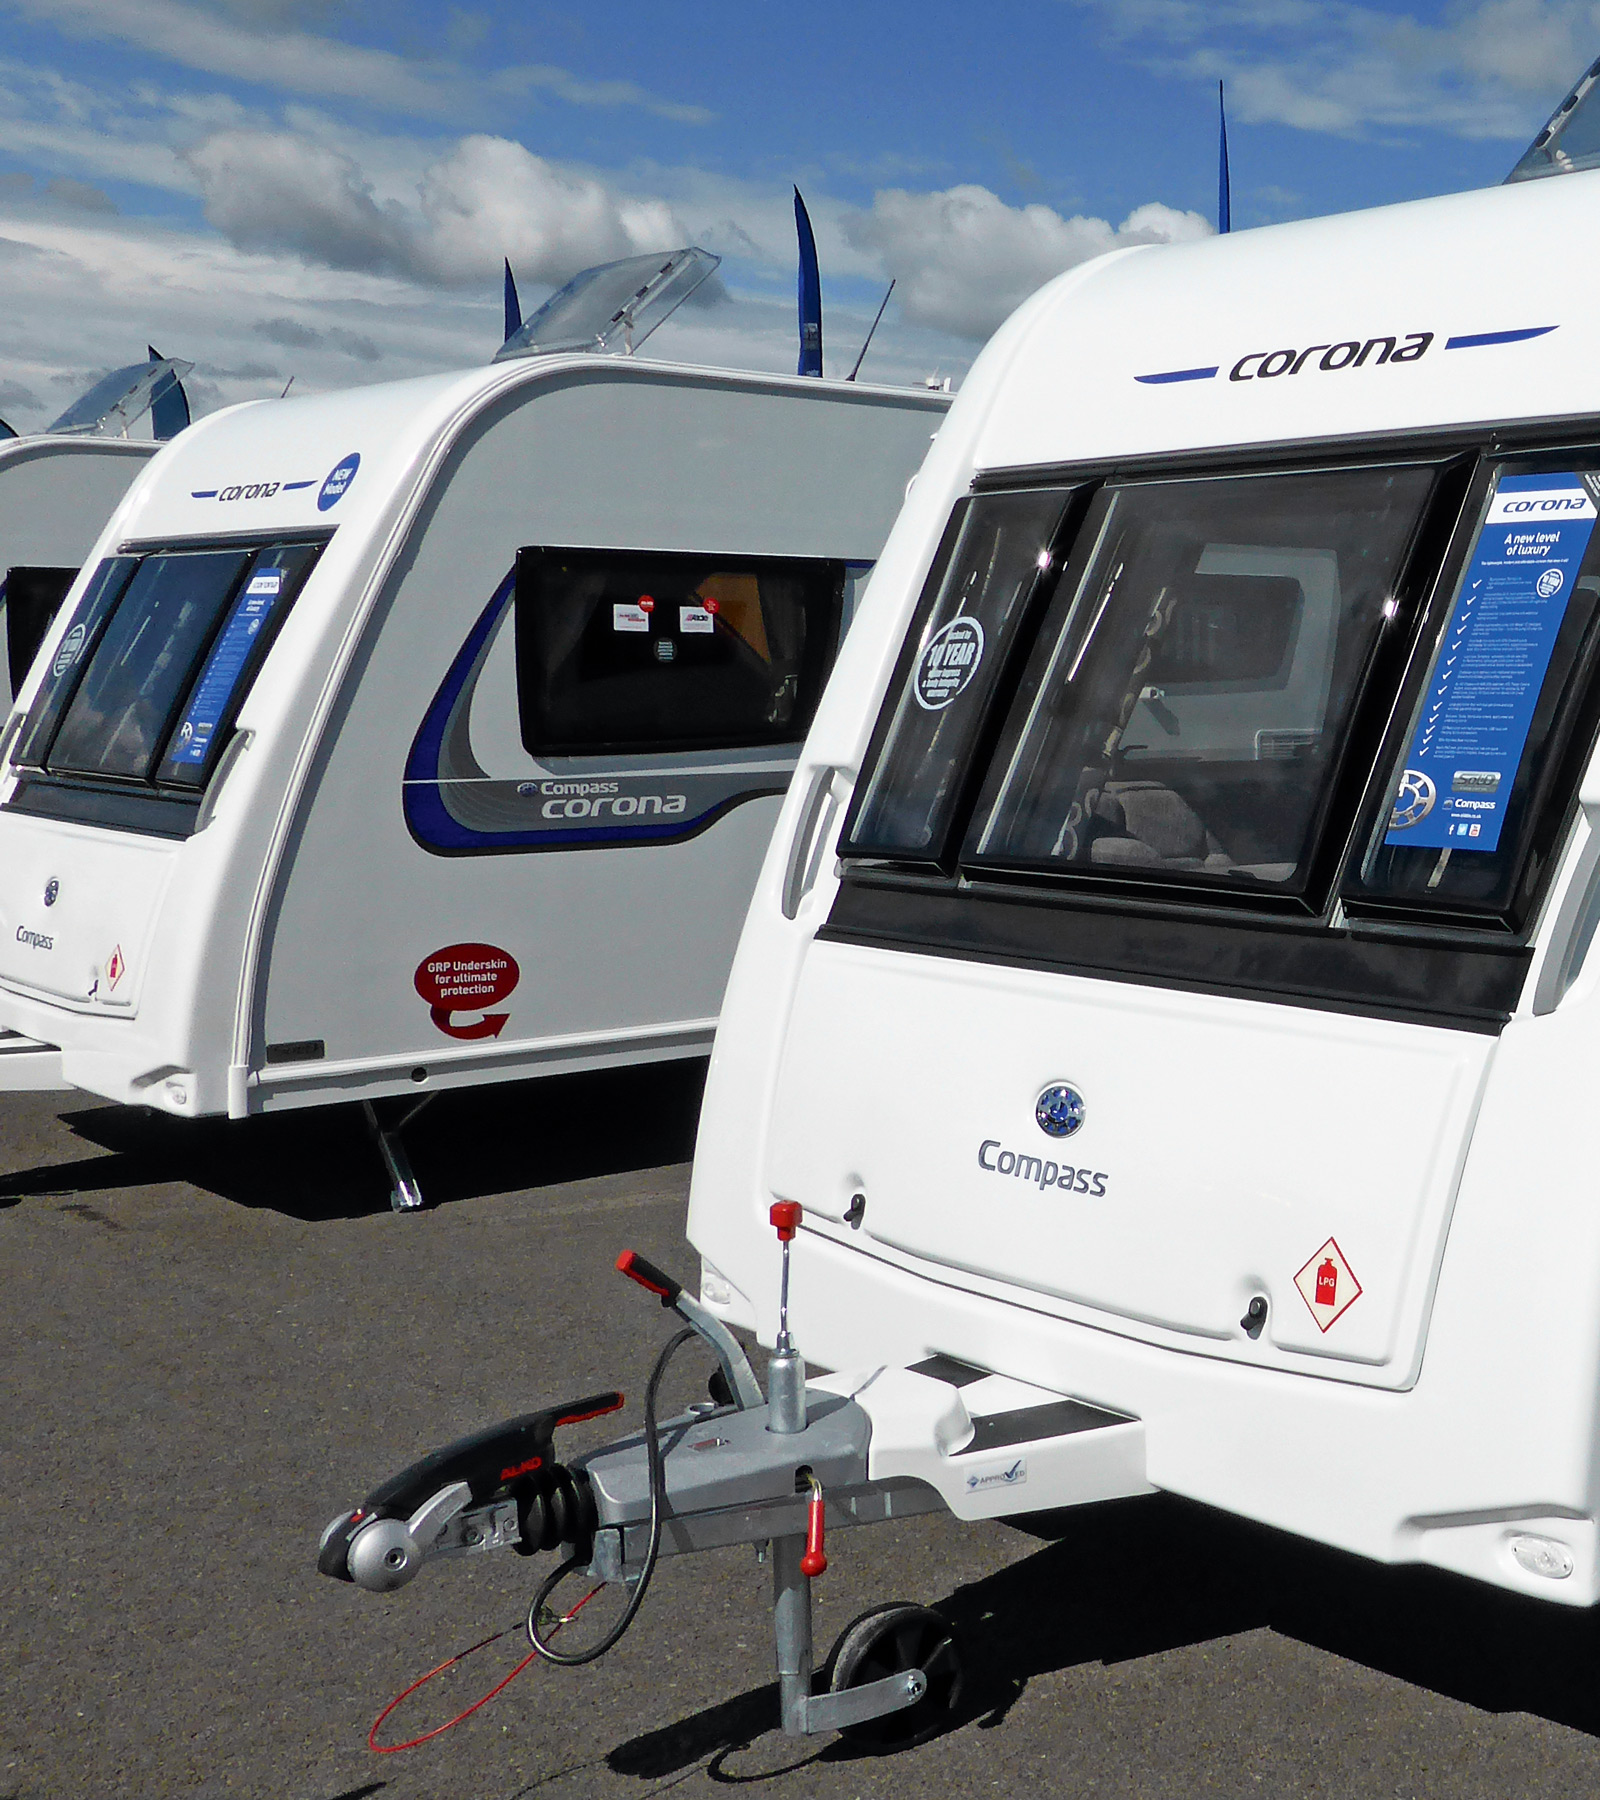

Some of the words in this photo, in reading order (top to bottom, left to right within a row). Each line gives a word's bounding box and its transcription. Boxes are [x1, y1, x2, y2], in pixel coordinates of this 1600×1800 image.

[1229, 331, 1435, 382] corona
[219, 482, 281, 502] corona
[1502, 497, 1588, 513] corona
[1504, 533, 1513, 545] A
[1513, 533, 1536, 544] new
[1536, 531, 1561, 543] level
[1506, 544, 1519, 556] of
[1518, 545, 1551, 557] luxury
[927, 644, 945, 667] 10
[943, 642, 976, 666] YEAR
[541, 781, 619, 796] Compass
[541, 794, 687, 819] corona
[1454, 798, 1497, 810] Compass
[16, 925, 54, 950] Compass
[427, 962, 451, 973] GRP
[453, 958, 508, 972] Underskin
[435, 974, 451, 985] for
[453, 972, 498, 984] ultimate
[440, 984, 495, 999] protection
[977, 1139, 1109, 1198] Compass
[1318, 1276, 1335, 1287] LPG
